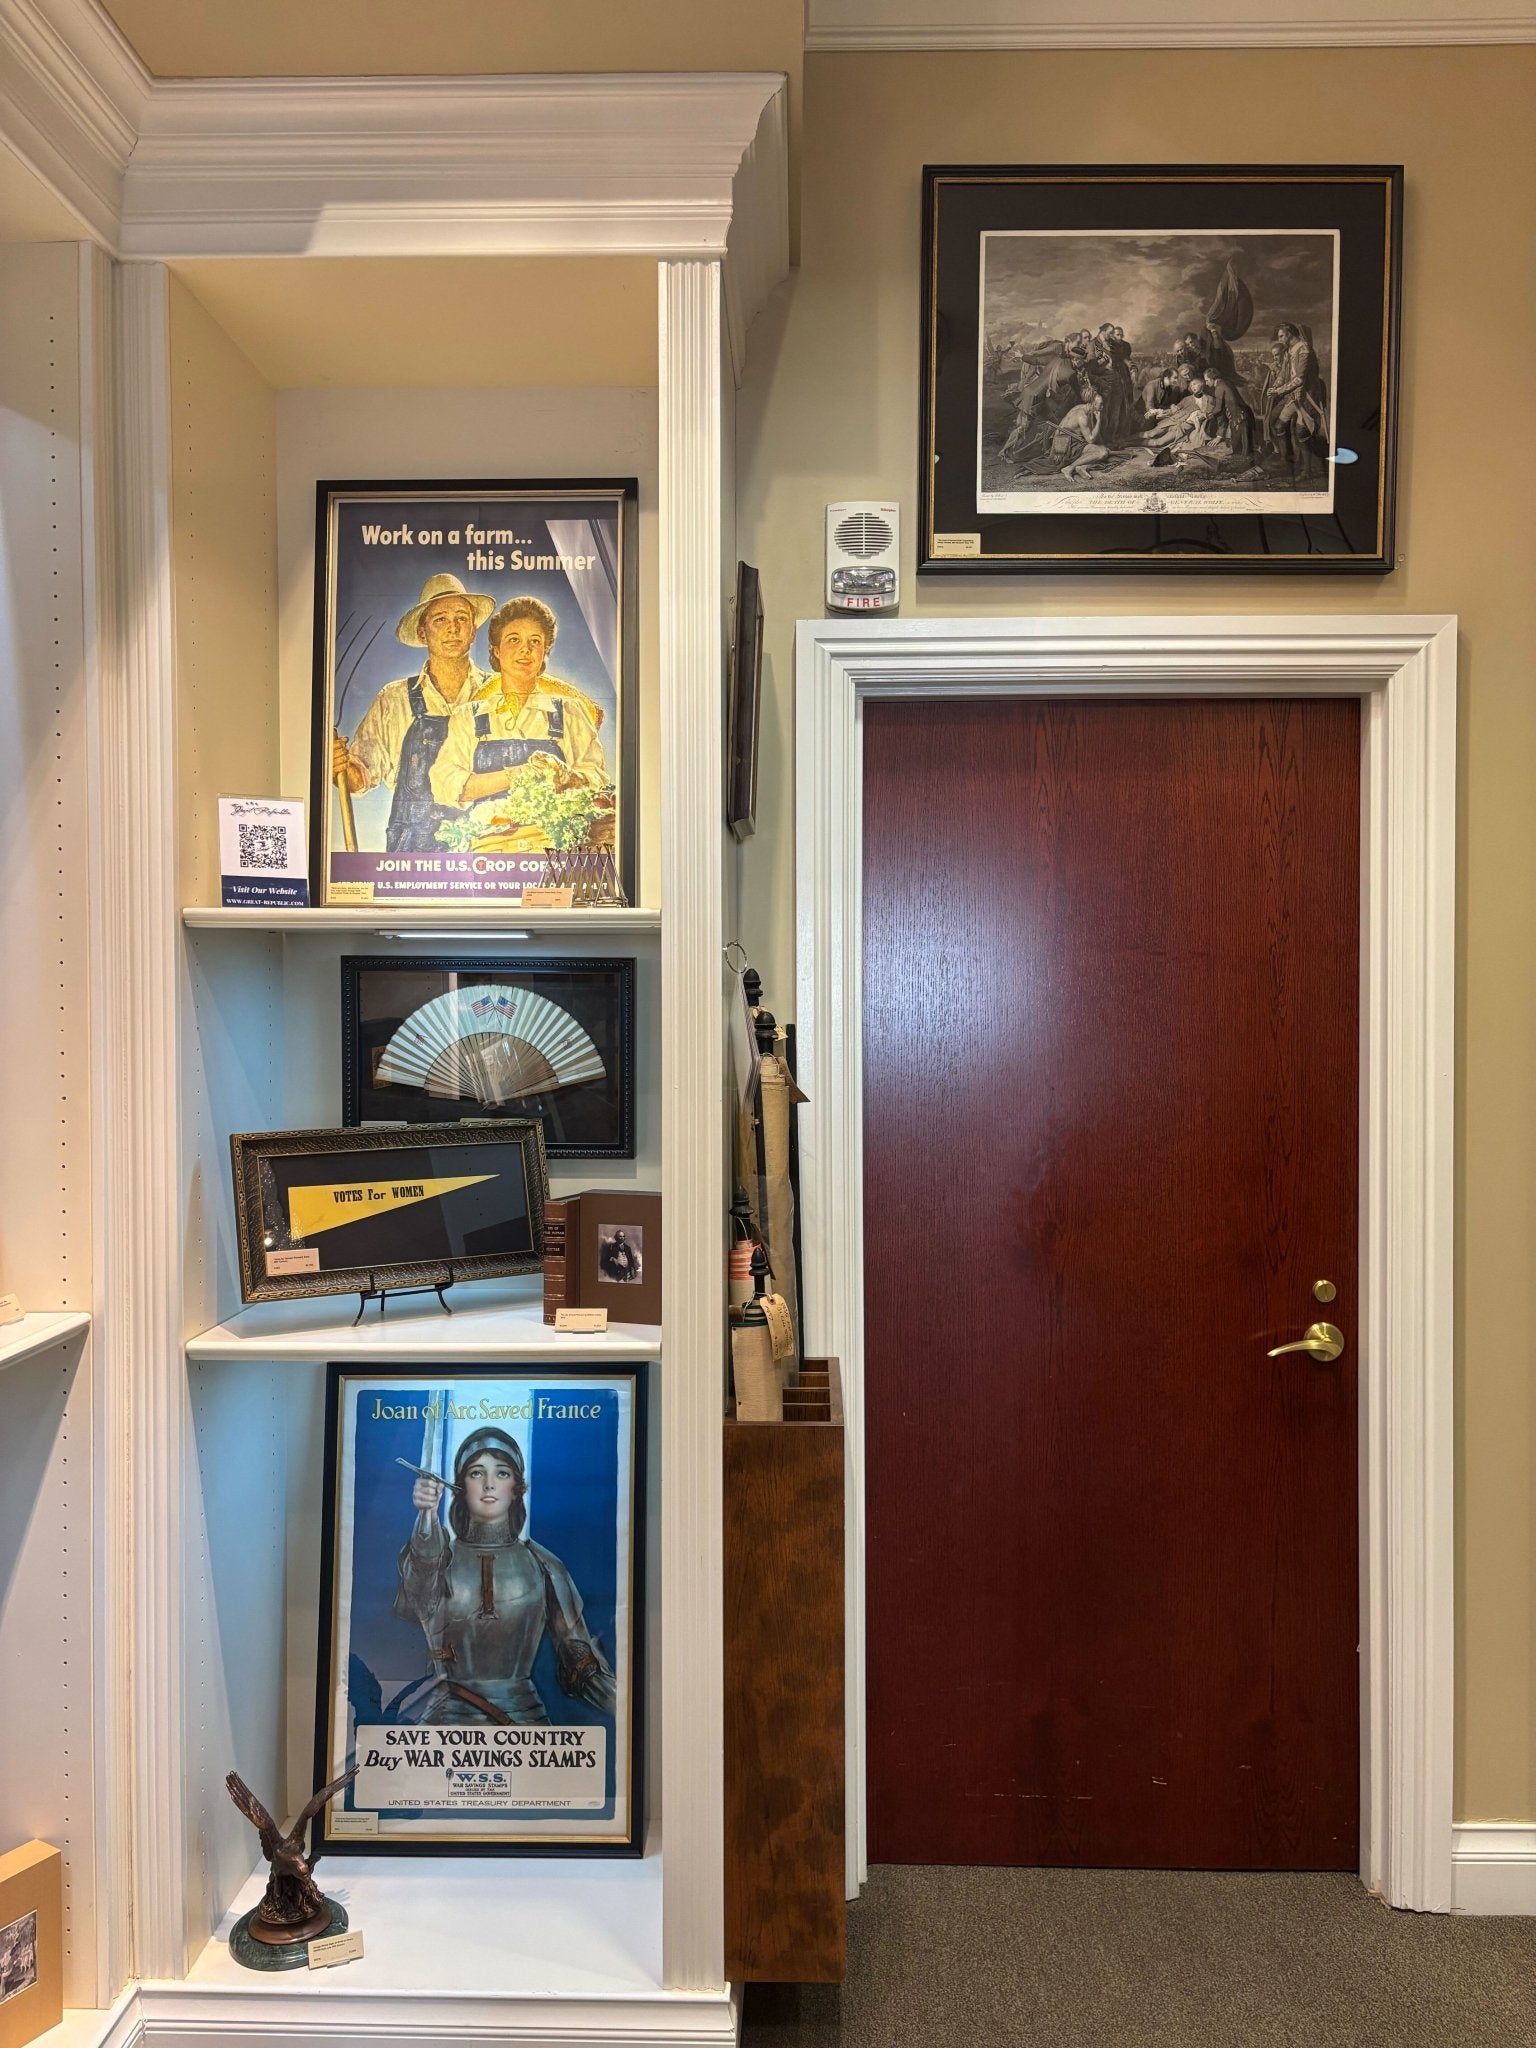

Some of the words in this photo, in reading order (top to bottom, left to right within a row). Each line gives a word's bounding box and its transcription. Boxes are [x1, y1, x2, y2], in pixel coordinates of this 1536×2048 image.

[361, 524, 414, 545] Work
[418, 530, 443, 545] on
[448, 530, 460, 545] a
[465, 524, 532, 545] farm...
[467, 550, 505, 571] this
[510, 550, 596, 571] Summer
[847, 597, 880, 607] FIRE
[376, 860, 411, 872] JOIN
[415, 860, 441, 872] THE
[445, 860, 472, 872] U.S.
[472, 856, 515, 875] CROP
[232, 885, 250, 894] Visit
[251, 886, 267, 894] Our
[269, 887, 298, 895] Website
[394, 882, 448, 890] EMPLOYMENT
[450, 882, 482, 890] SERVICE
[226, 898, 304, 906] WWW.GREAT-REPUBLIC.COM
[333, 1189, 363, 1203] VOTES
[368, 1188, 386, 1200] For
[391, 1185, 425, 1199] WOMEN
[371, 1398, 418, 1421] Joan
[422, 1397, 442, 1420] of
[445, 1399, 477, 1420] Arc
[479, 1398, 533, 1420] Saved
[537, 1397, 602, 1420] France
[385, 1730, 430, 1746] SAVE
[438, 1730, 487, 1746] YOUR
[493, 1730, 586, 1746] COUNTRY
[364, 1751, 403, 1771] Buy
[405, 1750, 445, 1768] WAR
[452, 1750, 523, 1768] SAVINGS
[528, 1750, 596, 1768] STAMPS
[455, 1773, 507, 1782] W.S.S.
